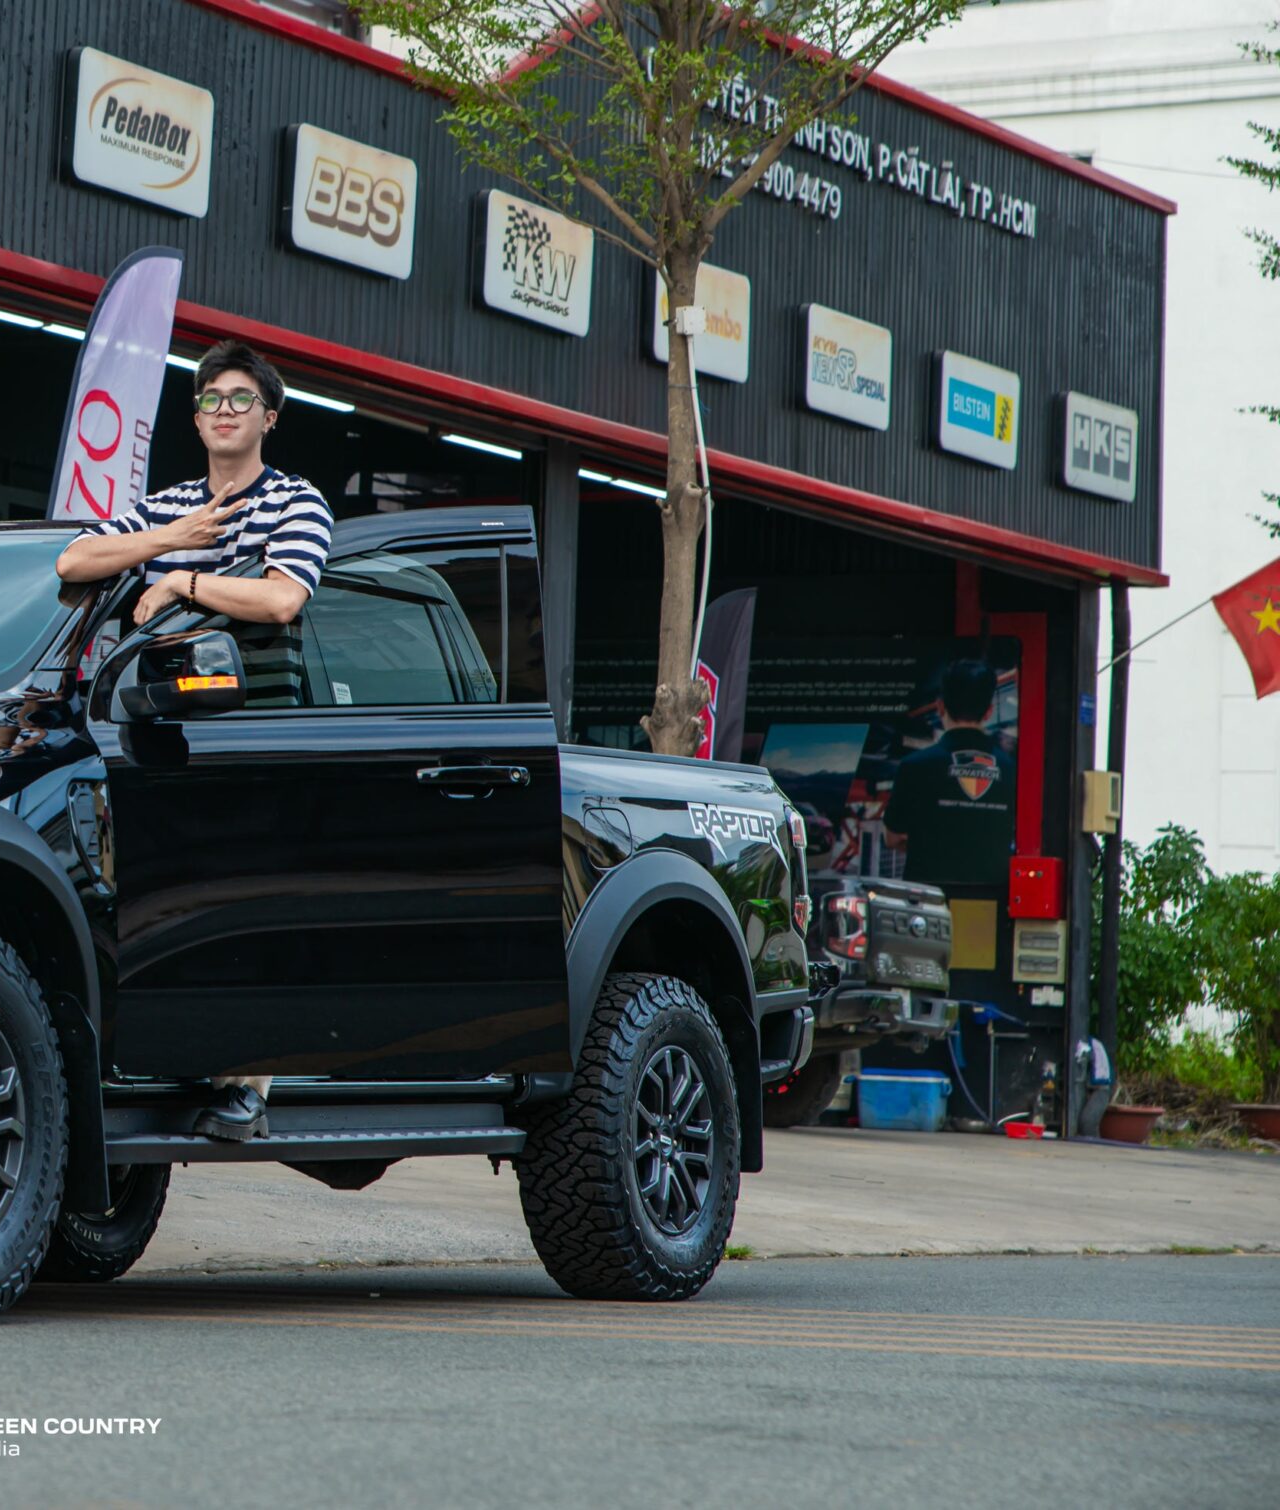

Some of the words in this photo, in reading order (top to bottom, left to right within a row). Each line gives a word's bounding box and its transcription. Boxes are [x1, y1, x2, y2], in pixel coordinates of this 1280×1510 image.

[100, 134, 140, 155] MAXIMUM
[141, 148, 186, 170] RESPONSE
[101, 96, 191, 156] PedalBox
[305, 156, 404, 247] BBS
[798, 171, 842, 219] 4479
[513, 237, 576, 301] KW
[856, 375, 886, 402] SPECIAL
[952, 392, 991, 422] BILSTEIN
[1073, 413, 1132, 466] HKS
[687, 802, 783, 857] RAPTOR
